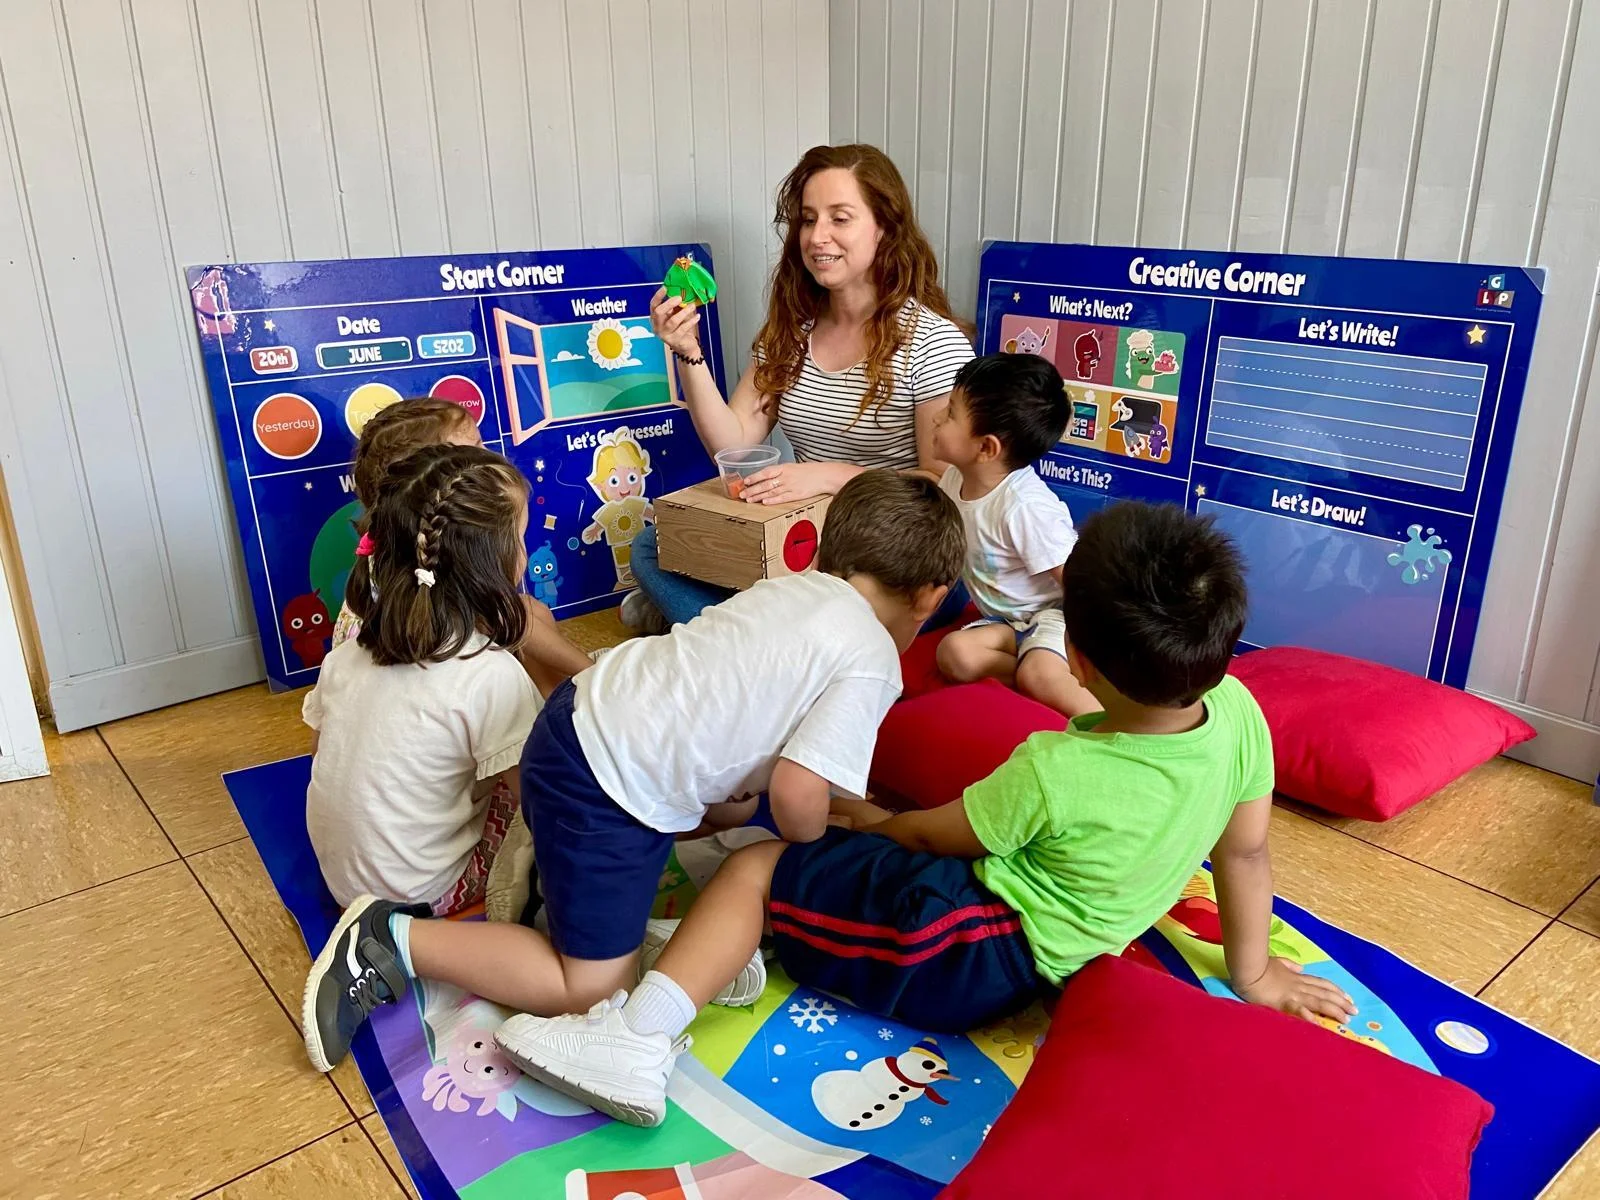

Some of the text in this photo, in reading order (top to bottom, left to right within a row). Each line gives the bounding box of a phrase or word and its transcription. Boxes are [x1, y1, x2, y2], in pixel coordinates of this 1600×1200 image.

[439, 260, 565, 291] Start Corner
[1128, 256, 1307, 297] Creative Corner
[570, 295, 628, 317] Weather
[1049, 294, 1134, 321] What's Next?
[336, 315, 381, 336] Date
[1298, 317, 1400, 348] Let's Write!
[257, 350, 289, 367] 20th
[348, 346, 383, 364] JUNE
[257, 418, 316, 434] Yesterday
[566, 431, 597, 452] Let's
[628, 418, 674, 441] ressed!
[1039, 459, 1113, 490] What's This?
[1271, 488, 1367, 526] Let's Draw!
